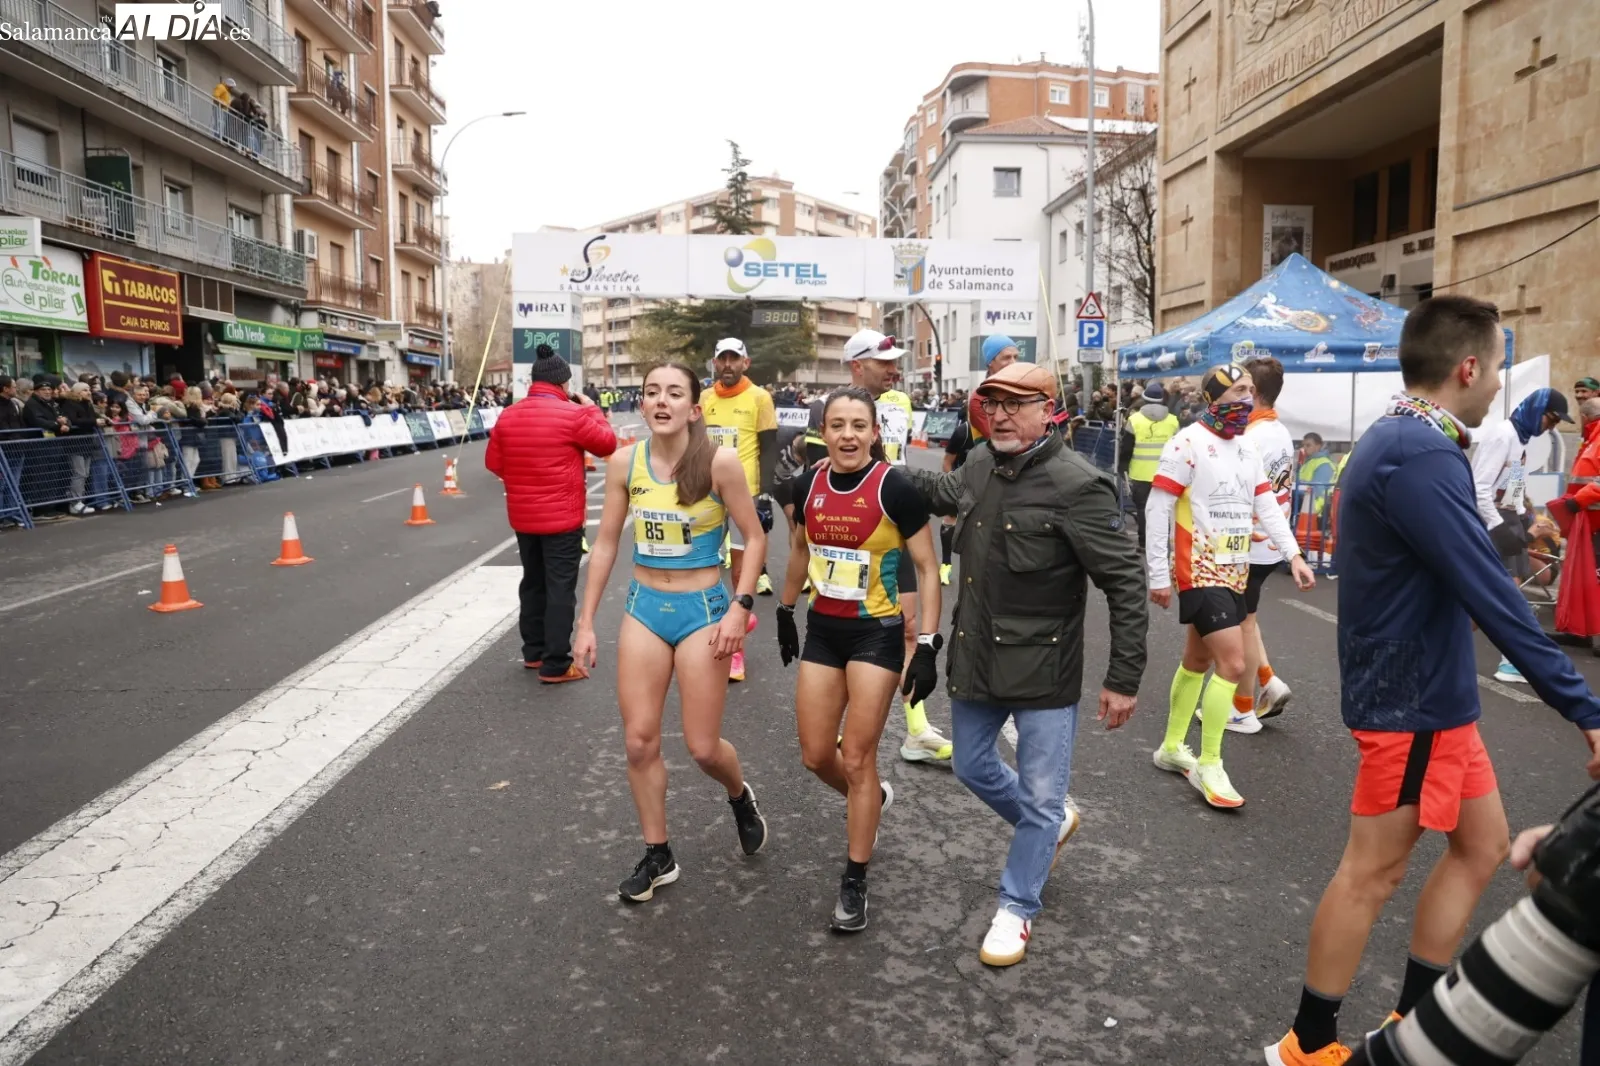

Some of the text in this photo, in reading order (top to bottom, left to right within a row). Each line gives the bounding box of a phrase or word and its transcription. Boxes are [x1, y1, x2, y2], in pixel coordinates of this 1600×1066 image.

[28, 259, 81, 288] TORCAL
[744, 262, 828, 279] SETEL
[928, 264, 1014, 278] Ayuntamiento
[560, 284, 641, 293] SALMANTINA
[795, 278, 828, 287] Grupo
[928, 279, 1014, 292] de Salamanca
[122, 278, 177, 305] TABACOS
[23, 290, 66, 310] el pilar
[120, 315, 170, 331] CAVA DE PUROS
[226, 322, 244, 340] Club
[245, 325, 265, 343] Verde
[304, 334, 320, 342] Club
[1083, 322, 1100, 345] P
[303, 340, 322, 349] Verde
[642, 510, 683, 521] SETEL
[645, 521, 664, 541] 85
[823, 525, 849, 533] VINO
[829, 533, 858, 541] TORO
[1226, 535, 1245, 551] 487
[822, 548, 863, 562] SETEL
[826, 560, 836, 580] 7
